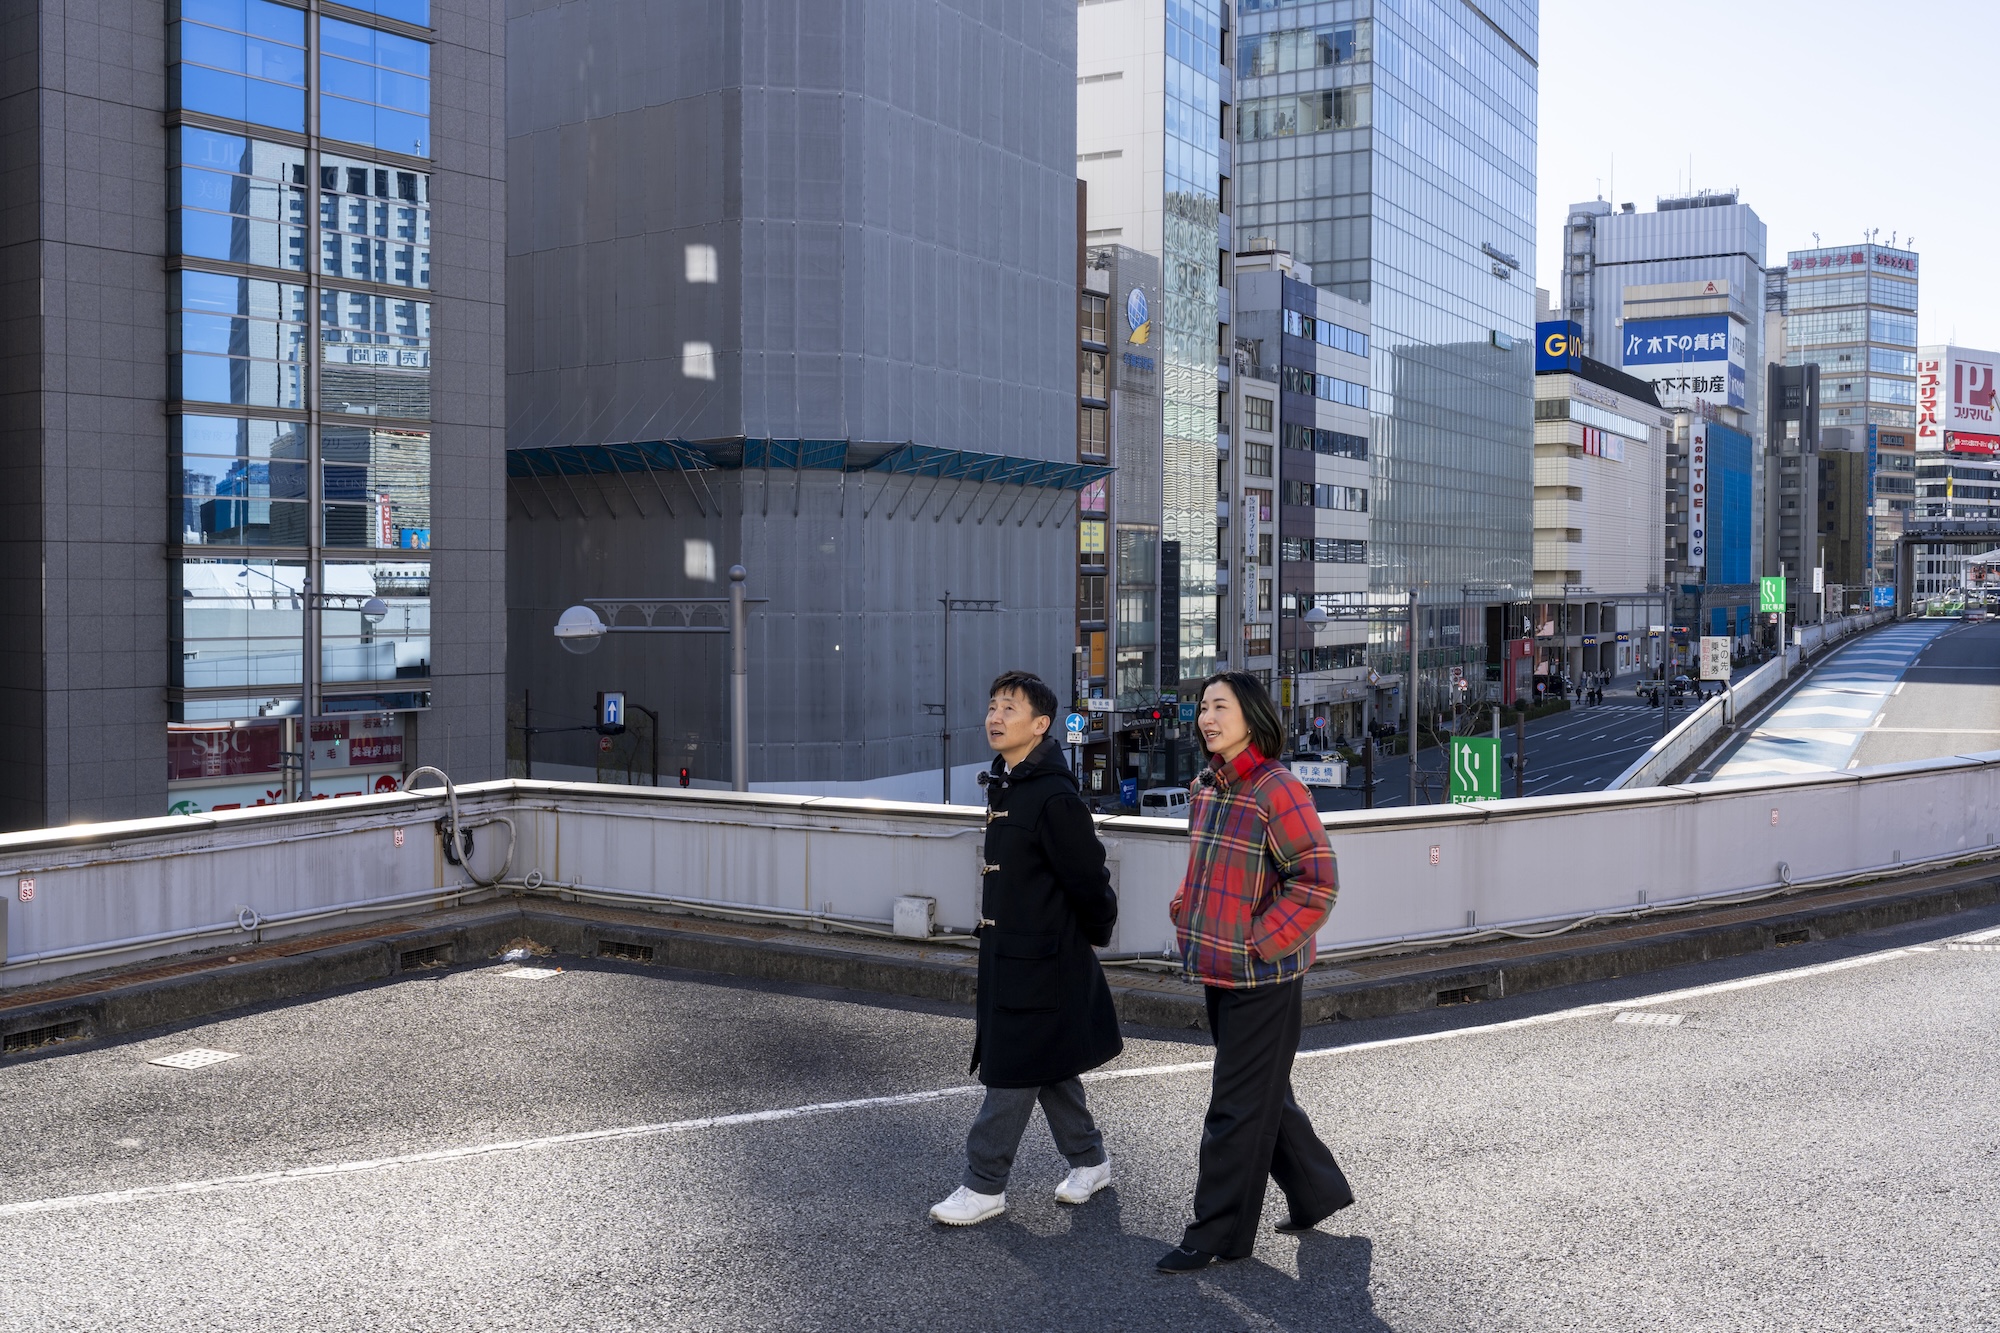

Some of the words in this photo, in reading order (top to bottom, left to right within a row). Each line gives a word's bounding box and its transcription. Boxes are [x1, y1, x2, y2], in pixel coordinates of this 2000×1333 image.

[1791, 252, 1864, 270] カラオケ館
[1647, 332, 1726, 354] 木下の賃貸
[1648, 375, 1725, 396] 木下不動産
[1918, 374, 1940, 437] プリマハム
[1954, 406, 1993, 422] プリマハム
[1701, 638, 1710, 678] 自動発行中
[1711, 641, 1719, 675] 乗継券
[1720, 638, 1729, 671] この先
[191, 729, 251, 756] SBC
[1298, 765, 1333, 777] 有楽橋
[22, 888, 33, 898] S3
